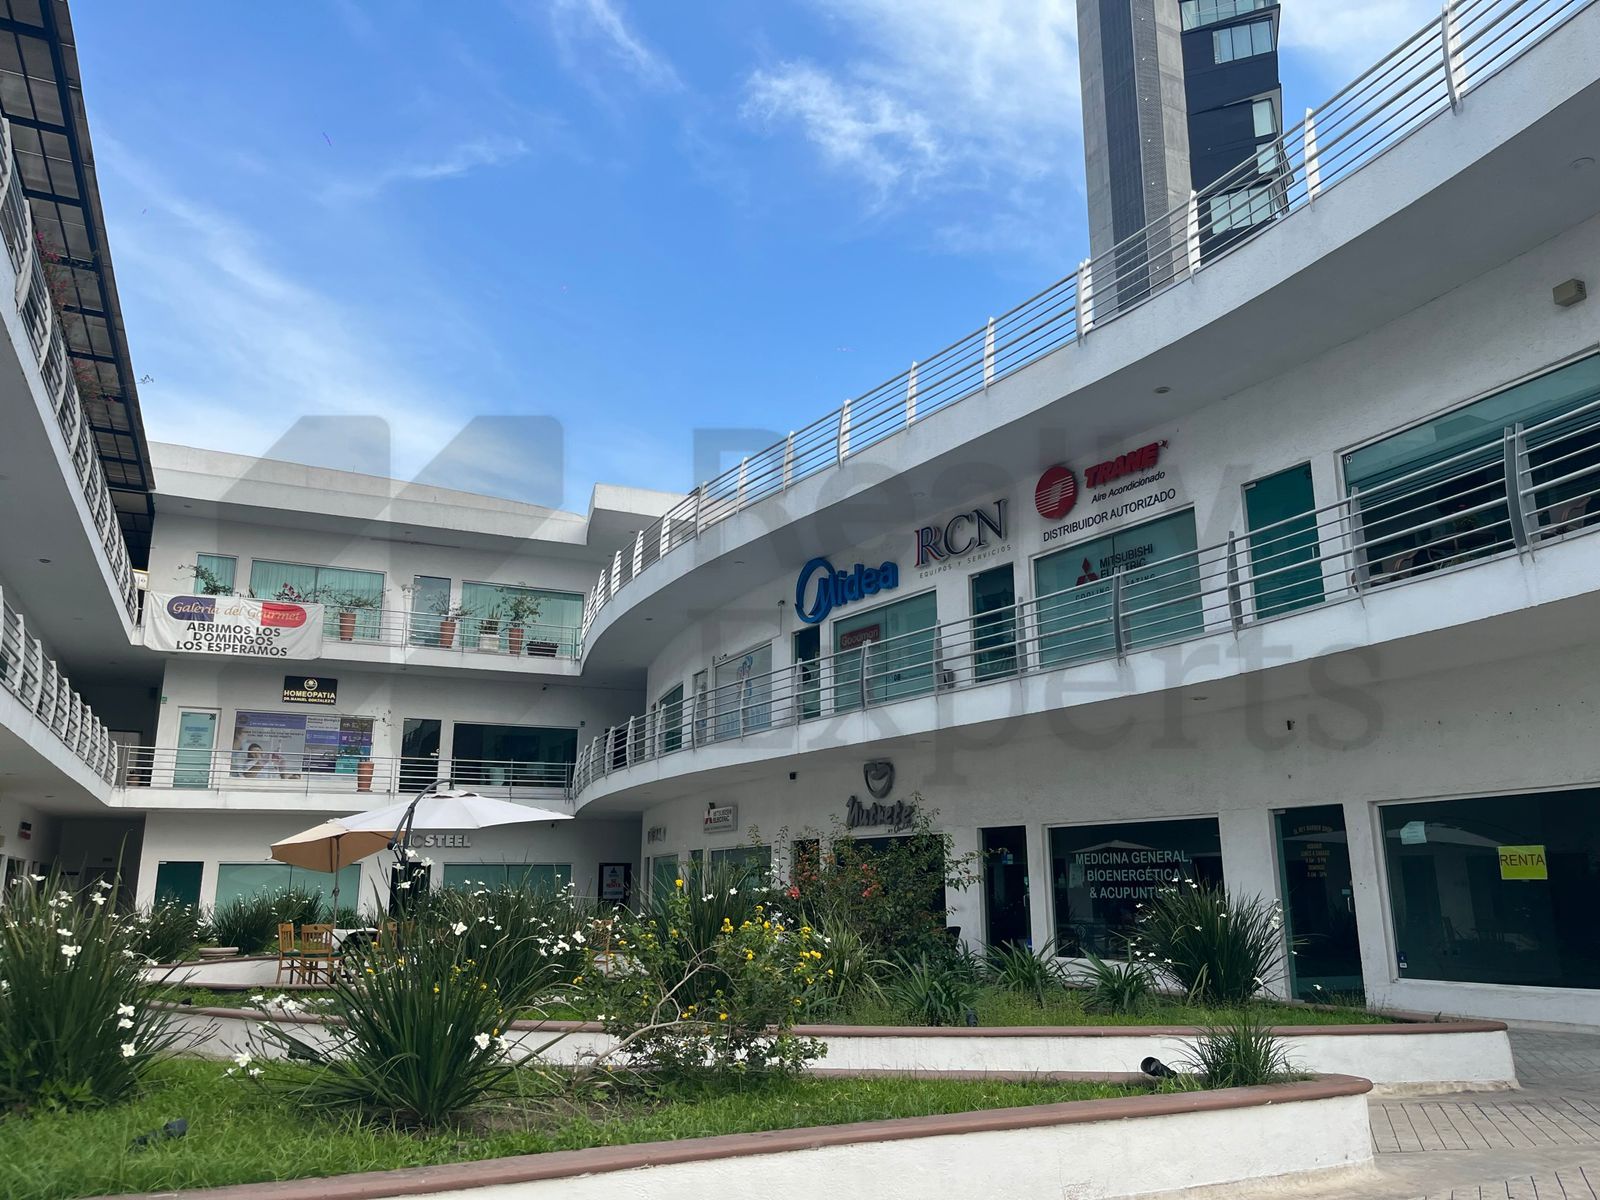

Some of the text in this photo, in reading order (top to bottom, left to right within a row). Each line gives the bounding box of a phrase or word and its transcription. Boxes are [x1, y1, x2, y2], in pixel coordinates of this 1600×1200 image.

[1084, 442, 1160, 489] TRANE
[1091, 471, 1166, 504] Aire Acondicionado
[1043, 488, 1176, 541] DISTRIBUIDOR AUTORIZADO
[914, 499, 1008, 567] RCN
[920, 563, 952, 578] EQUIPOS
[967, 544, 1012, 564] SERVICIOS
[1100, 543, 1153, 568] MITSUBISHI
[795, 557, 898, 624] Midea
[224, 603, 242, 616] del
[247, 607, 302, 622] Gourmet
[186, 622, 281, 637] ABRIMOS LOS
[193, 631, 274, 646] DOMINGOS
[176, 640, 288, 657] LOS ESPERAMOS
[283, 689, 336, 700] HOMEOPATIA
[1075, 850, 1193, 865] MEDICINA GENERAL,
[1500, 854, 1545, 866] RENTA
[1087, 866, 1181, 882] BIOENERGÉTICA
[1089, 886, 1098, 899] &
